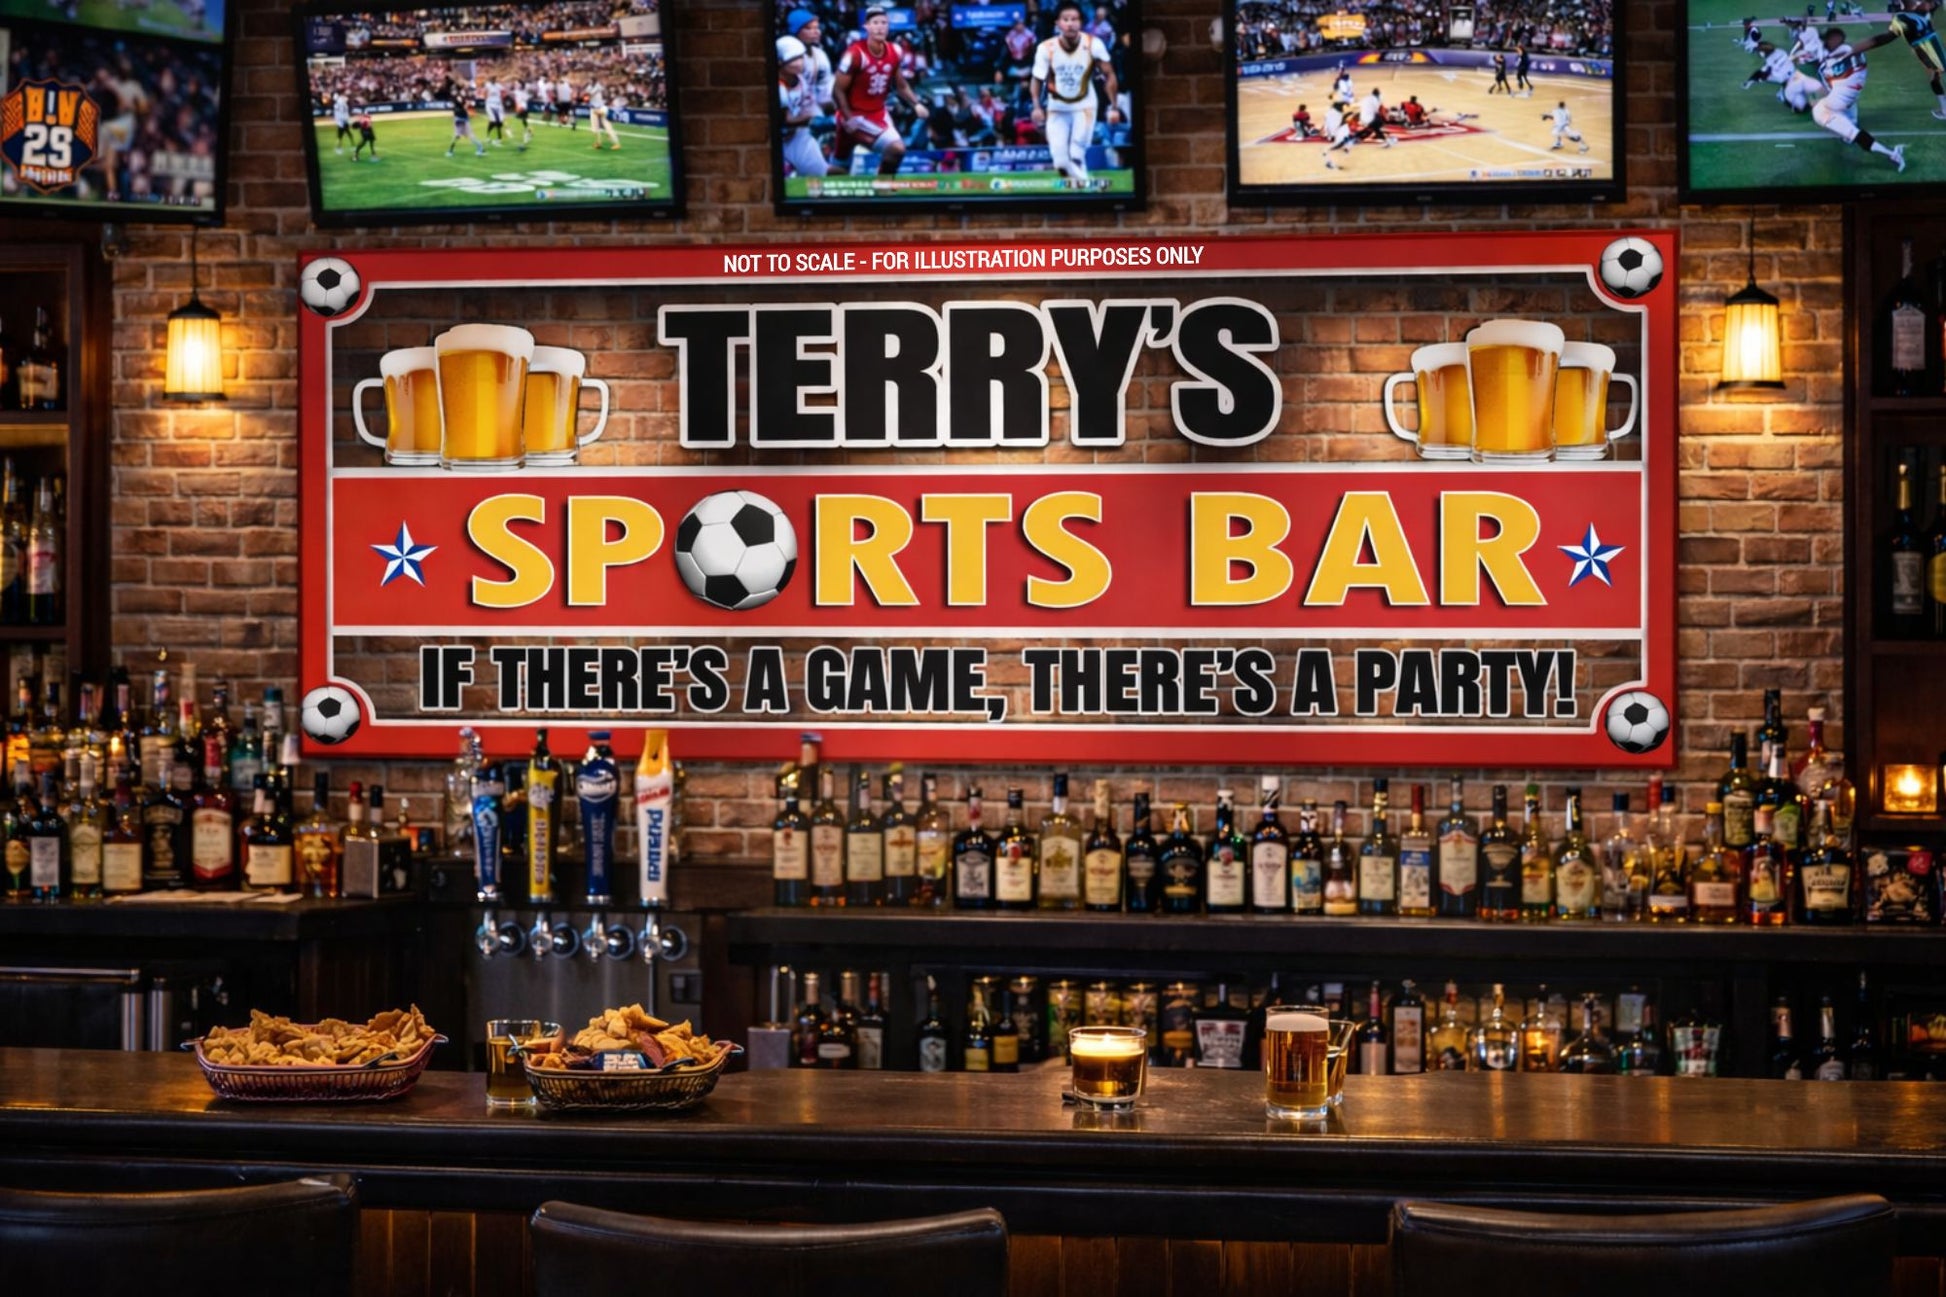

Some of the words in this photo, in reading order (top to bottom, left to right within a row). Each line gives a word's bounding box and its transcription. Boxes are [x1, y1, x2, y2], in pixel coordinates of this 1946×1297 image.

[724, 254, 762, 272] NOT
[766, 253, 790, 271] TO
[795, 252, 855, 271] SCALE
[872, 251, 909, 270] FOR
[915, 249, 1045, 269] ILLUSTRATION
[1051, 247, 1151, 266] PURPOSES
[1156, 246, 1204, 264] ONLY
[658, 297, 1283, 448] TERRY'S
[1190, 491, 1548, 606] BAR
[420, 645, 475, 711] IF
[490, 645, 730, 713] THERE'S
[743, 646, 790, 713] A
[805, 645, 1007, 722] GAME,
[1022, 647, 1276, 716] THERE'S
[1290, 648, 1339, 716] A
[1354, 648, 1578, 718] PARTY!
